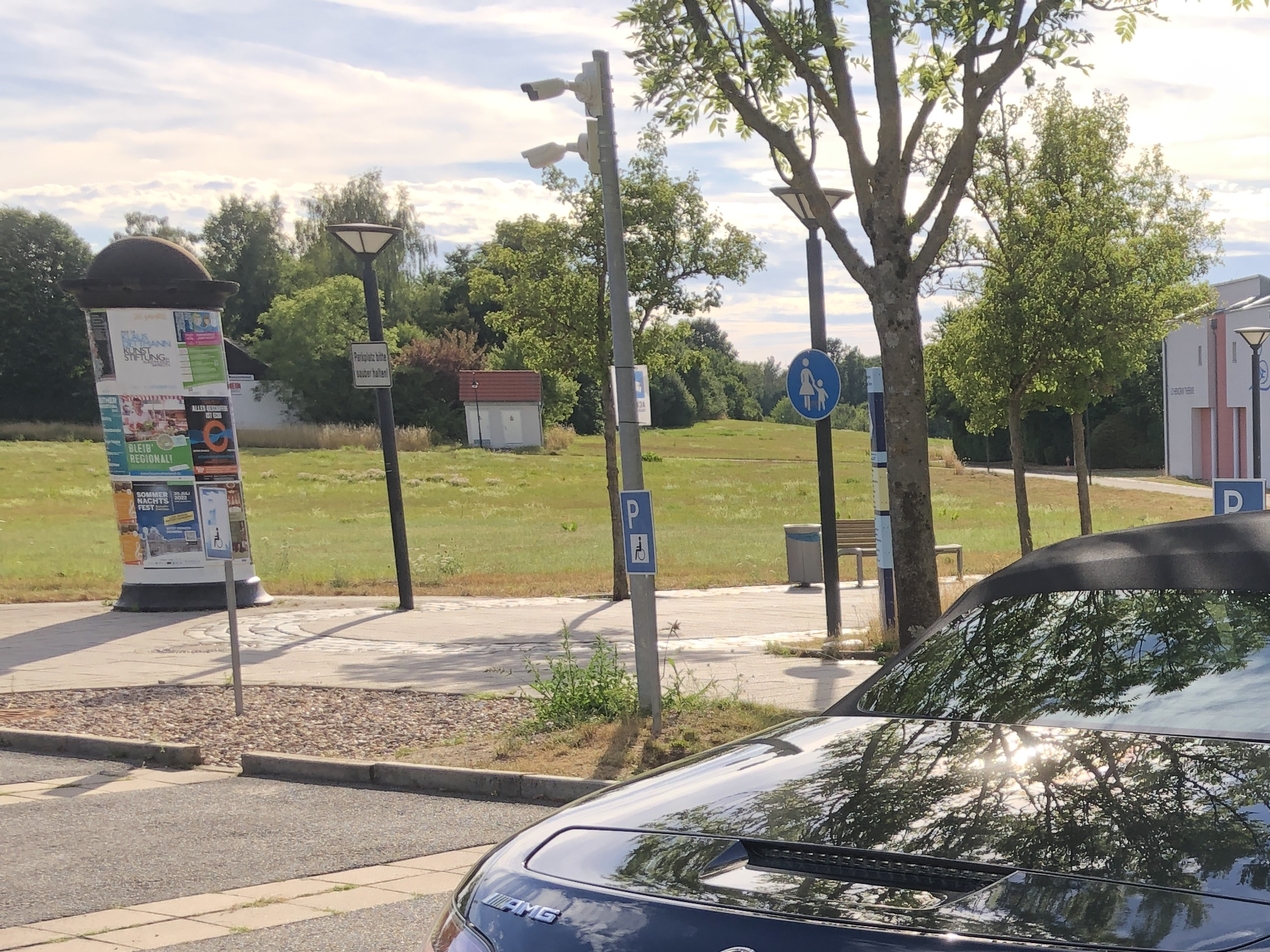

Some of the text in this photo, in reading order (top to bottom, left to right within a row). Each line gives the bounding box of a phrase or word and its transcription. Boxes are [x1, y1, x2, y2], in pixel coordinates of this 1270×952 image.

[123, 347, 151, 355] KUNST
[354, 352, 387, 362] Parkplatz bitte
[357, 369, 371, 378] sauber
[130, 454, 173, 464] REGIONAL!
[1224, 489, 1243, 514] P
[626, 499, 640, 529] P
[501, 898, 562, 924] AMG
